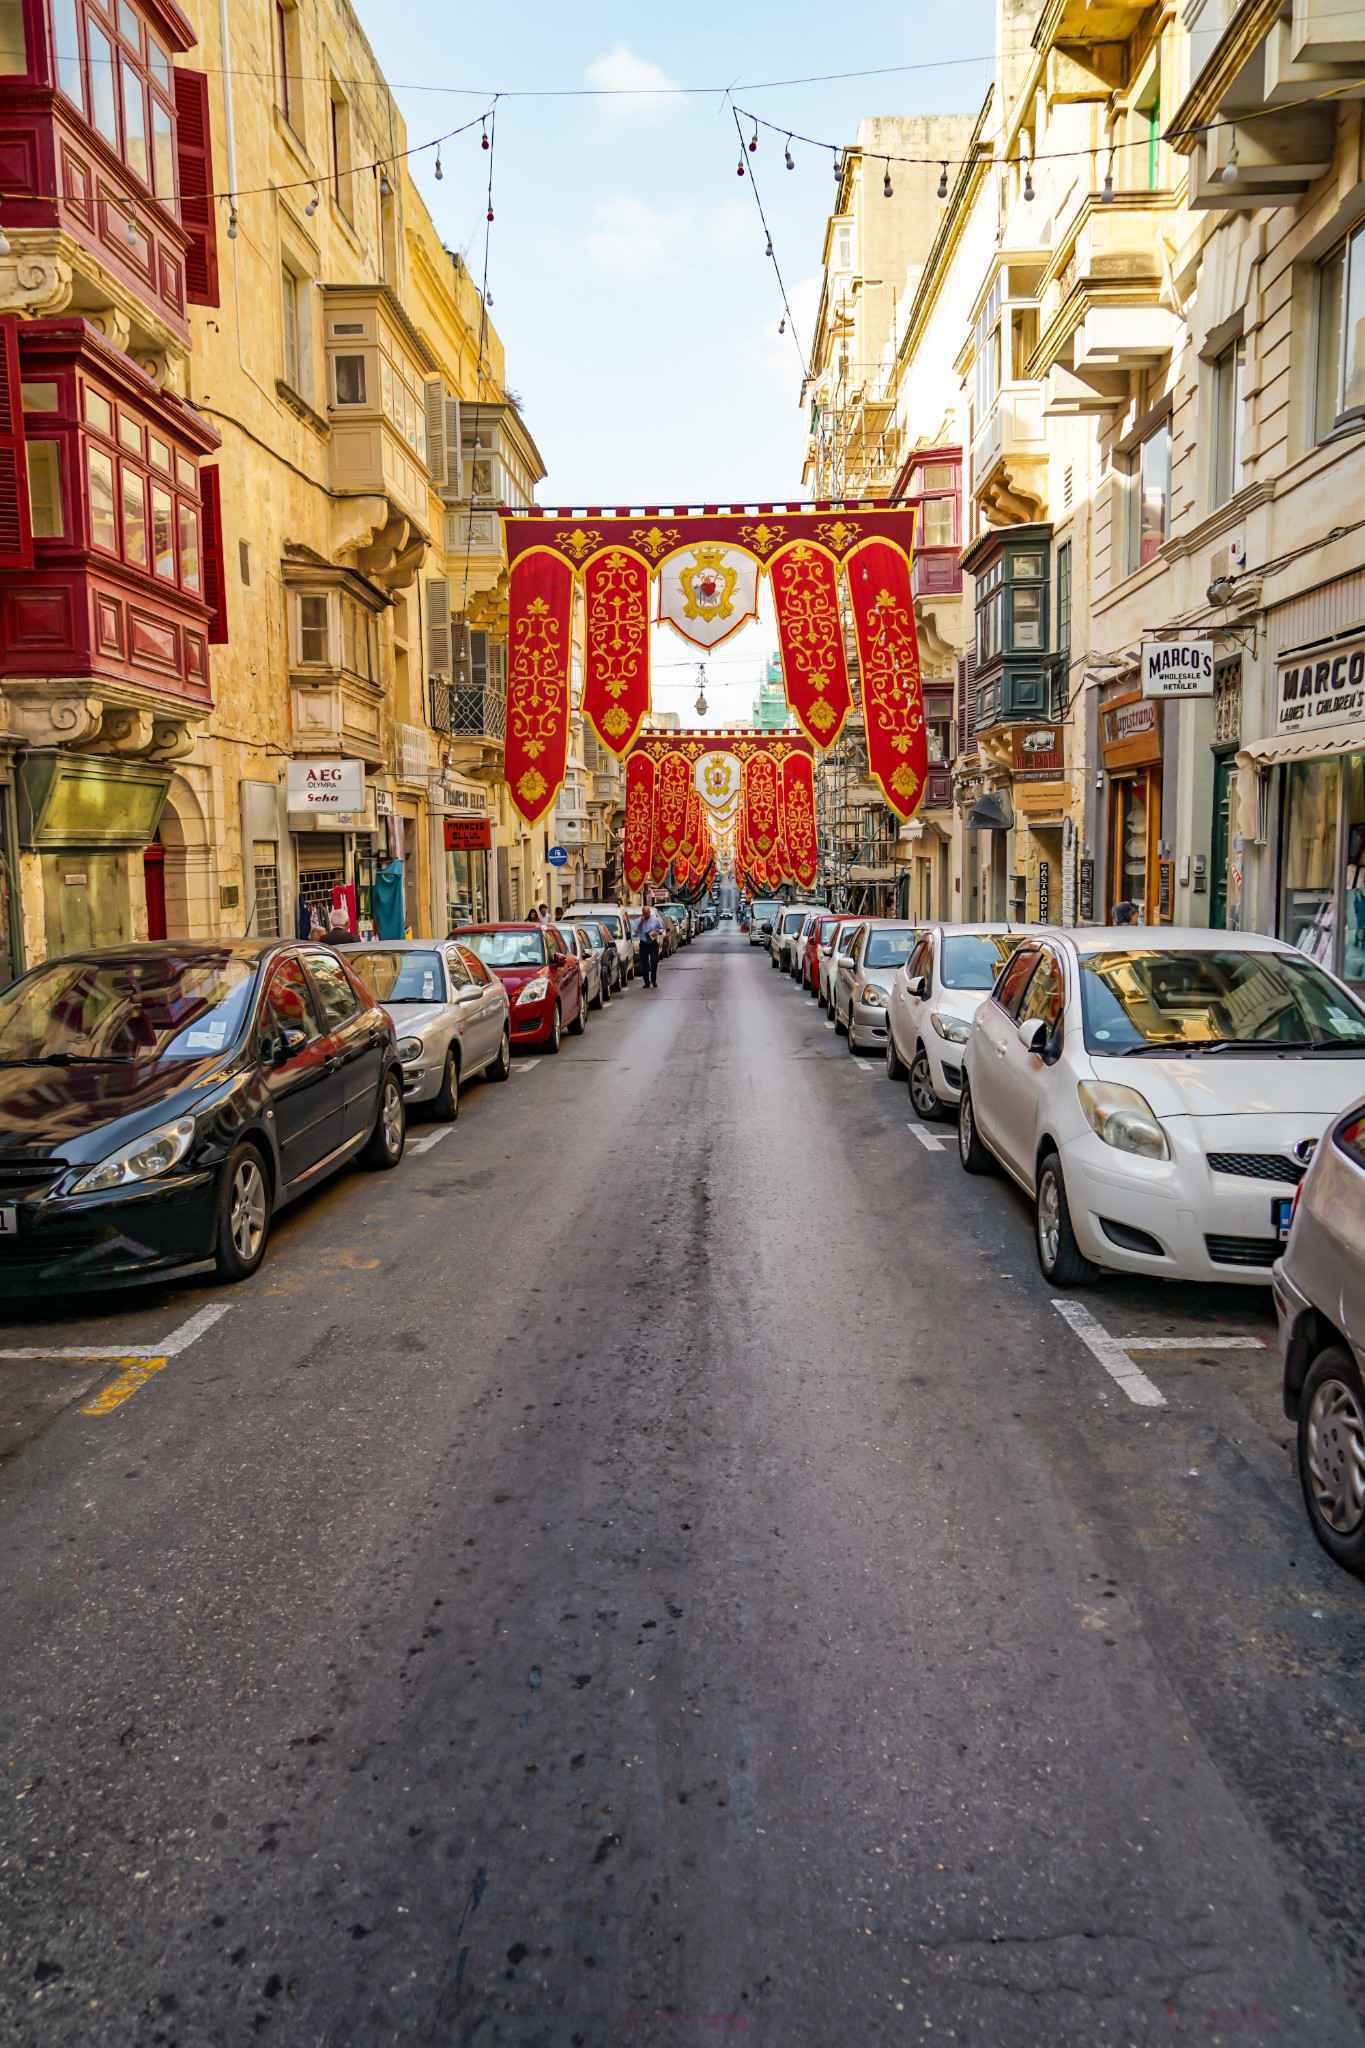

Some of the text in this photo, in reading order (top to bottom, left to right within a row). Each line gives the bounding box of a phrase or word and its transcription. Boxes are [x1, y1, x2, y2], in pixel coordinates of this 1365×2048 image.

[1149, 648, 1212, 680] MARCO'S
[1280, 705, 1305, 723] LADIES
[1316, 691, 1365, 716] CHILDREN'S
[306, 768, 342, 781] AEG
[308, 781, 337, 789] OLYMPIA
